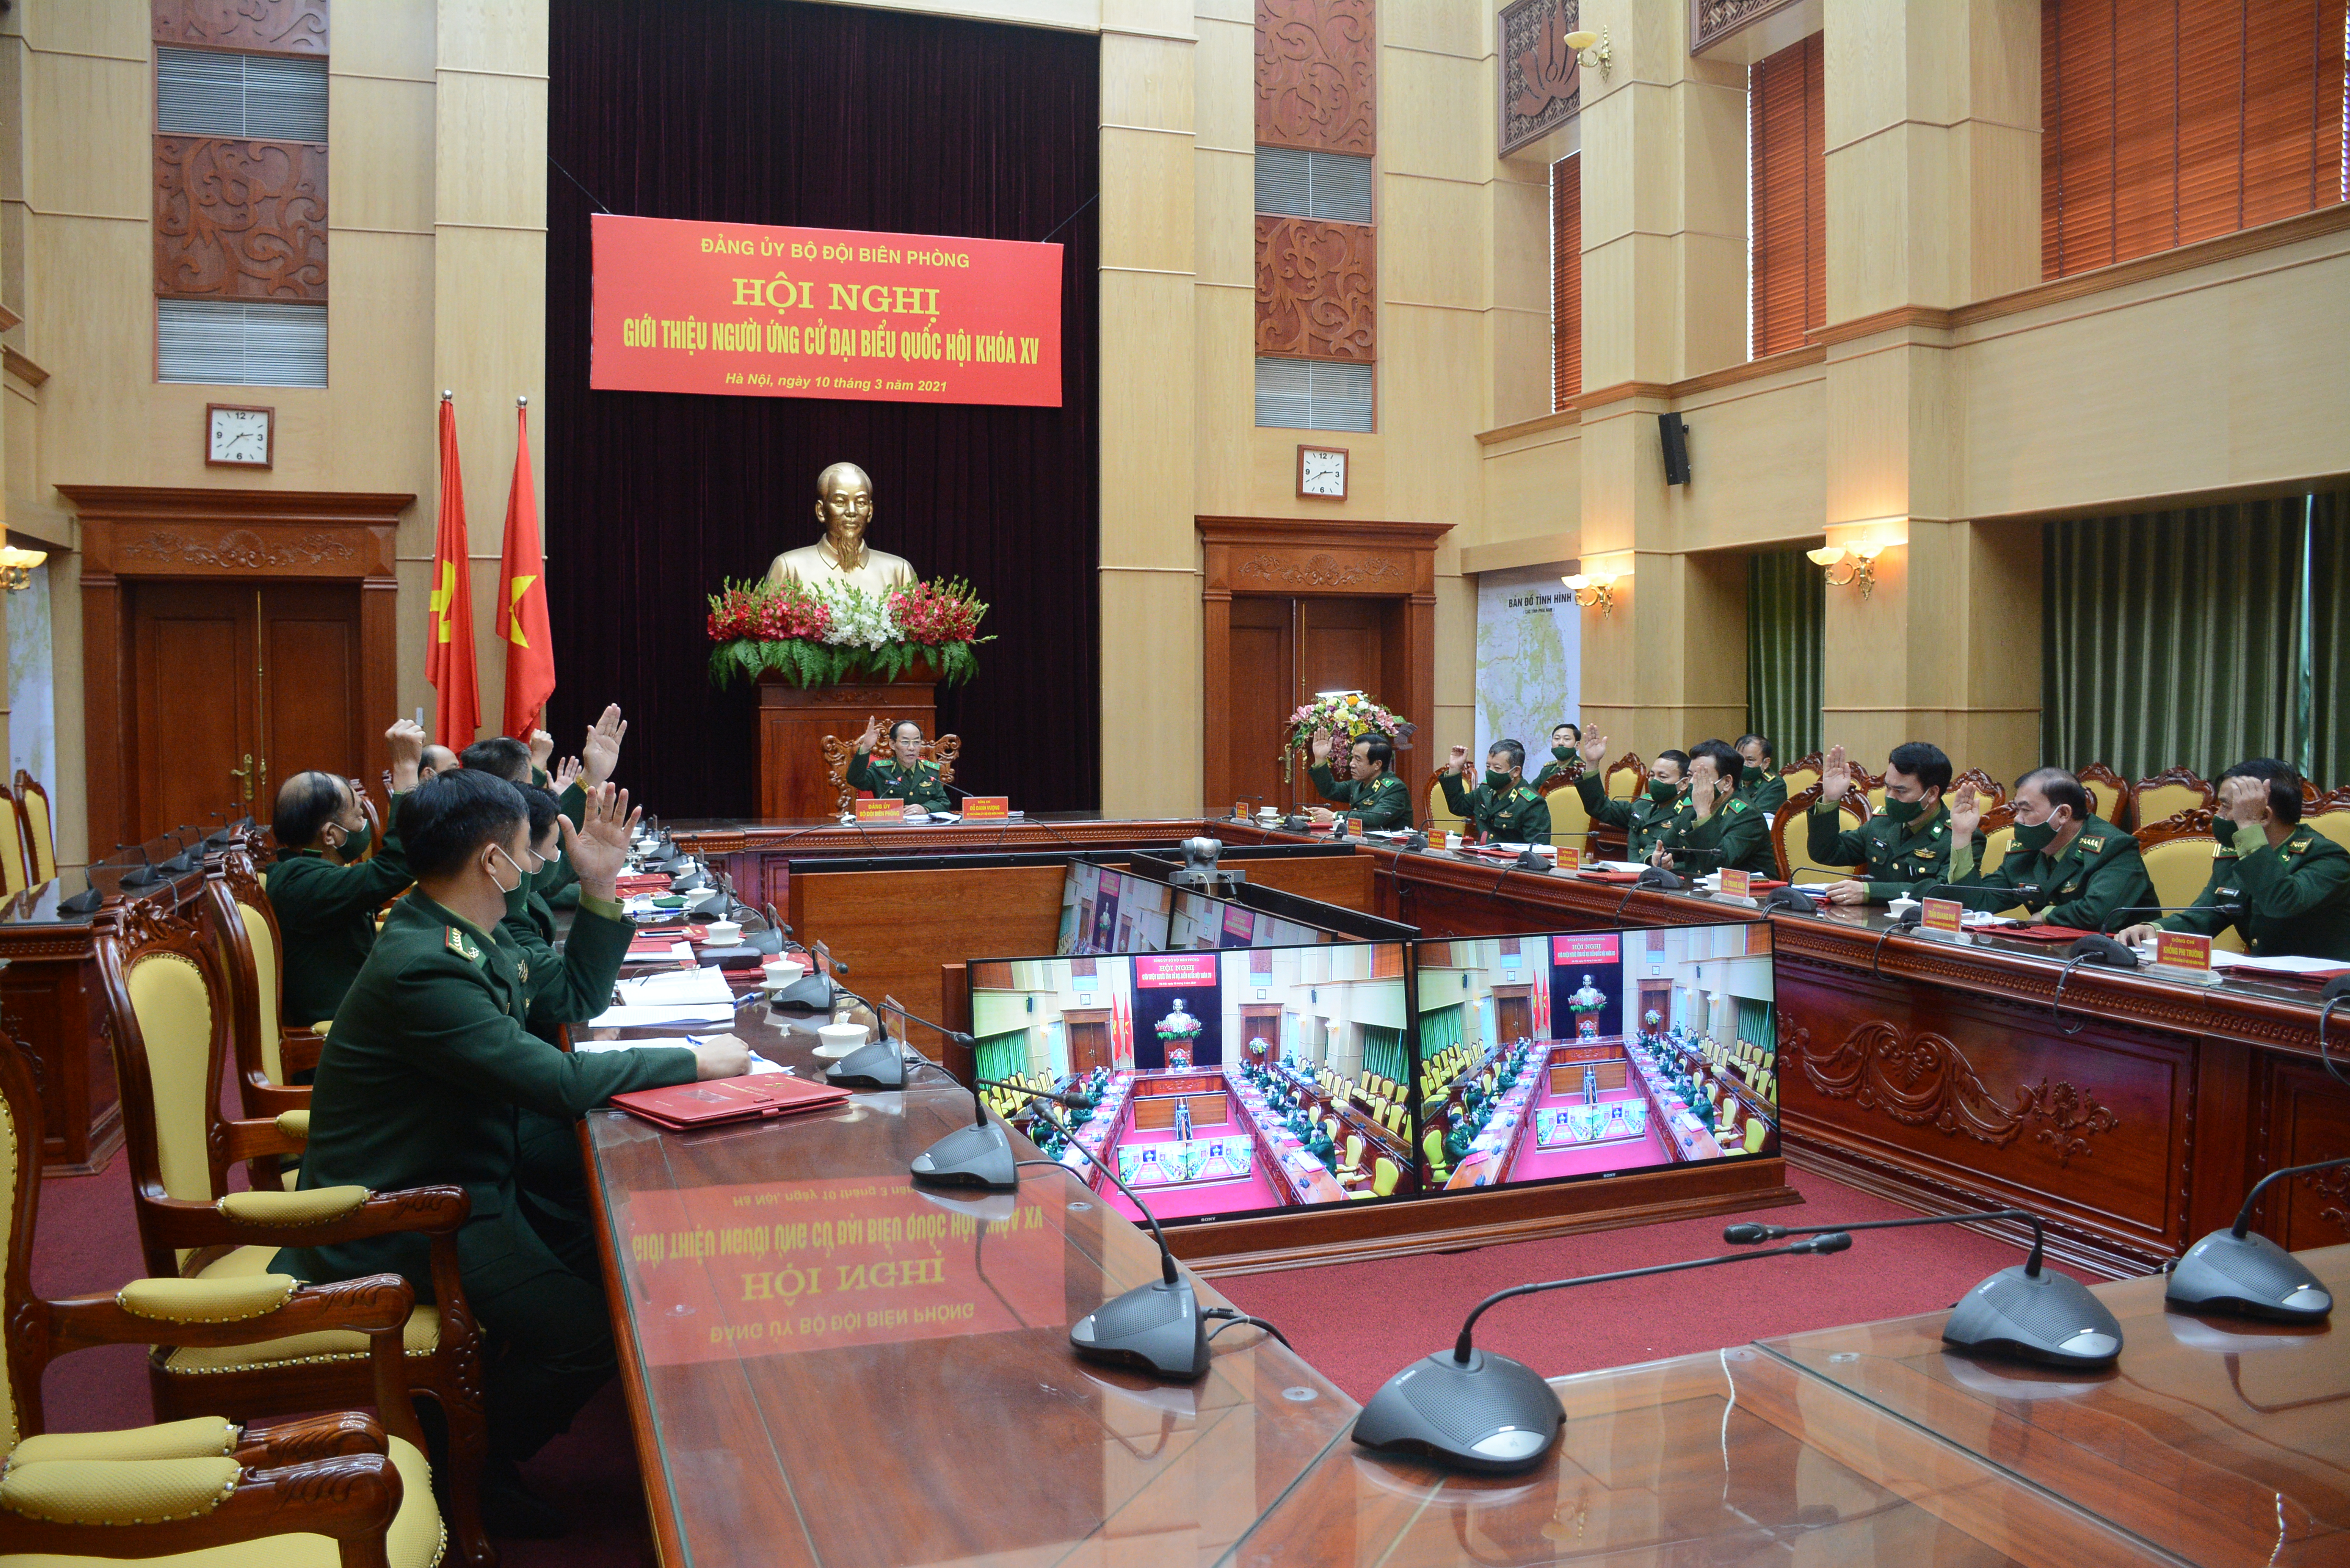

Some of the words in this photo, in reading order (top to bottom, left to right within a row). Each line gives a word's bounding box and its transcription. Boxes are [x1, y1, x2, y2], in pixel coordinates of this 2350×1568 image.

[701, 234, 755, 256] ĐẢNG
[761, 237, 786, 258] ỦY
[791, 241, 818, 262] BỘ
[822, 244, 854, 264] ĐỘI
[859, 245, 901, 264] BIÊN
[907, 249, 970, 269] PHÒNG
[732, 271, 815, 316] HỘI
[828, 283, 941, 324] NGHỊ
[624, 313, 657, 348] GIỚI
[661, 315, 708, 356] THIỆU
[712, 317, 762, 353] NGƯỜI
[767, 319, 800, 354] ỨNG
[804, 318, 828, 356] CỬ
[830, 328, 857, 363] ĐẠI
[861, 319, 896, 359] BIỂU
[901, 323, 942, 363] QUỐC
[947, 329, 972, 368] HỘI
[976, 331, 1017, 364] KHÓA
[1020, 338, 1040, 365] XV
[726, 373, 744, 385] Hà
[748, 374, 774, 388] Nội,
[778, 376, 812, 390] ngày
[816, 377, 831, 388] 10
[834, 378, 872, 392] tháng
[875, 379, 883, 390] 3
[886, 380, 914, 391] năm
[918, 381, 947, 393] 2021
[1508, 595, 1522, 607] BẢN
[1536, 594, 1551, 605] TÌNH
[1554, 592, 1572, 603] HÌNH
[1159, 964, 1173, 972] HỘI
